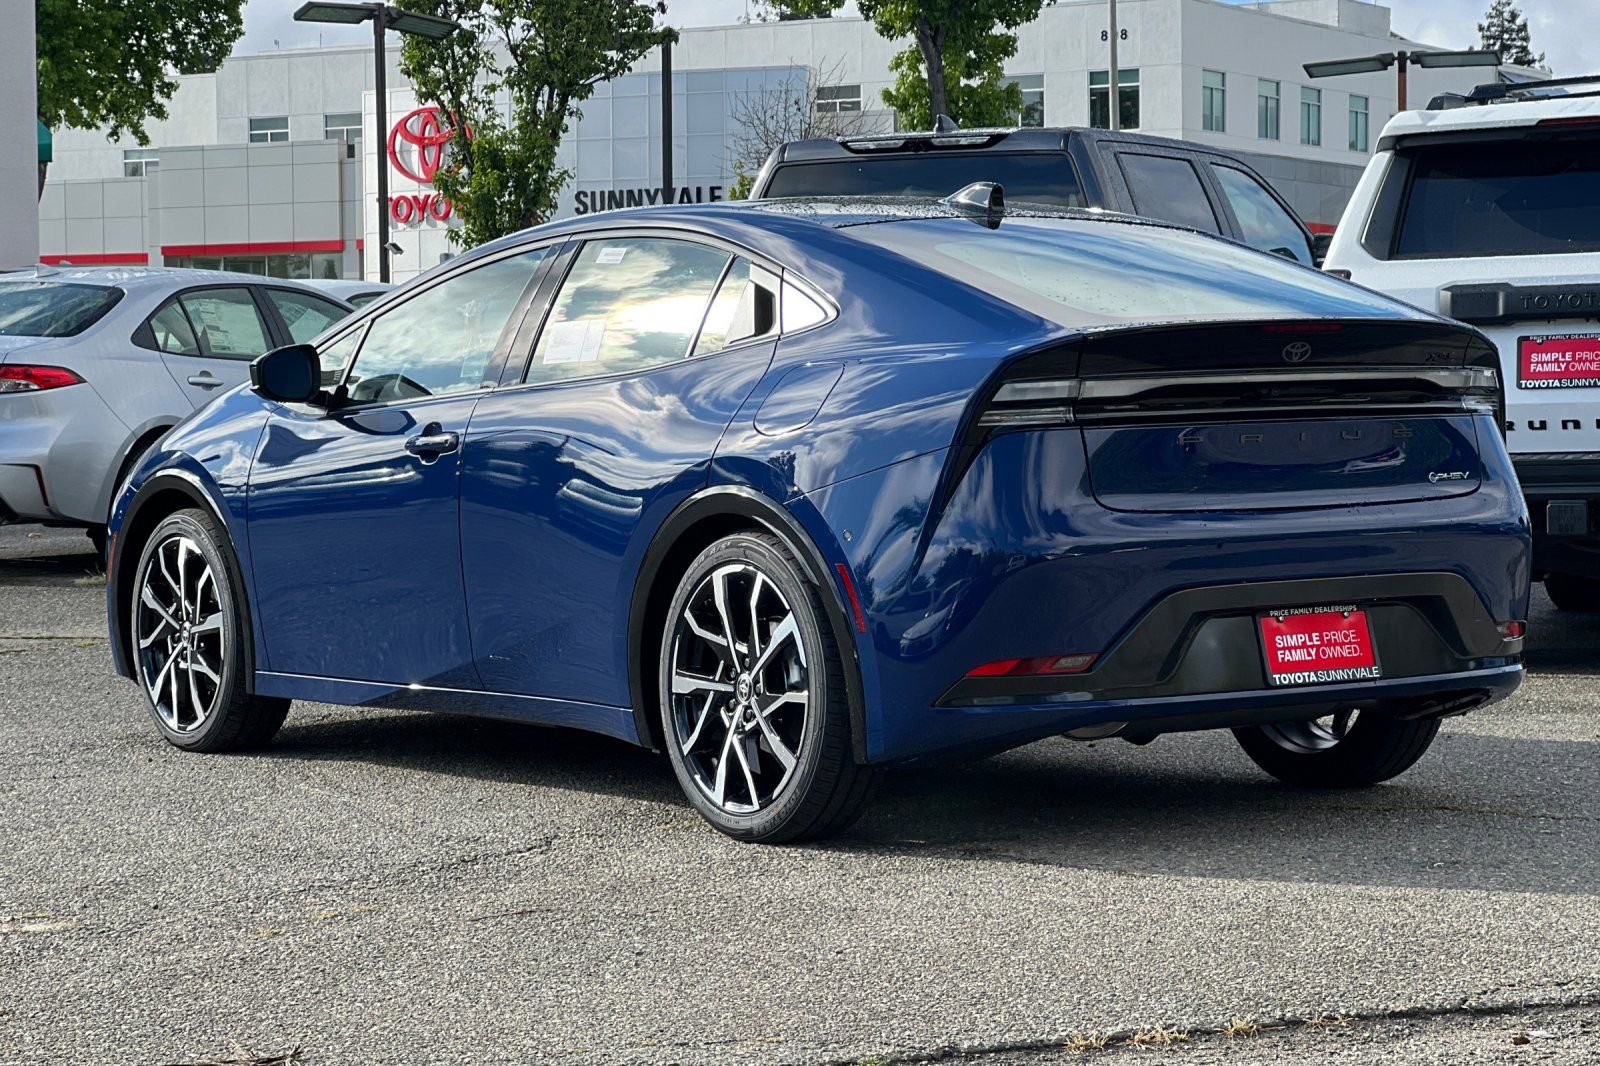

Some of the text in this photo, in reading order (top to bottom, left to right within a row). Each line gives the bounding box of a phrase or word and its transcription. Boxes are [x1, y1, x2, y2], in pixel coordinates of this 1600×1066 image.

[1520, 292, 1600, 310] TOYOT
[1530, 352, 1572, 362] SIMPLE
[1530, 363, 1567, 373] FAMILY
[1520, 379, 1560, 388] TOYOTA
[1290, 607, 1313, 615] FAMILY
[1314, 605, 1357, 614] DEALERSHIPS
[1275, 630, 1360, 648] SIMPLE PRICE.
[1277, 644, 1363, 663] FAMILY OWNED.
[1272, 666, 1380, 685] TOYOTA SUNNYVALE
